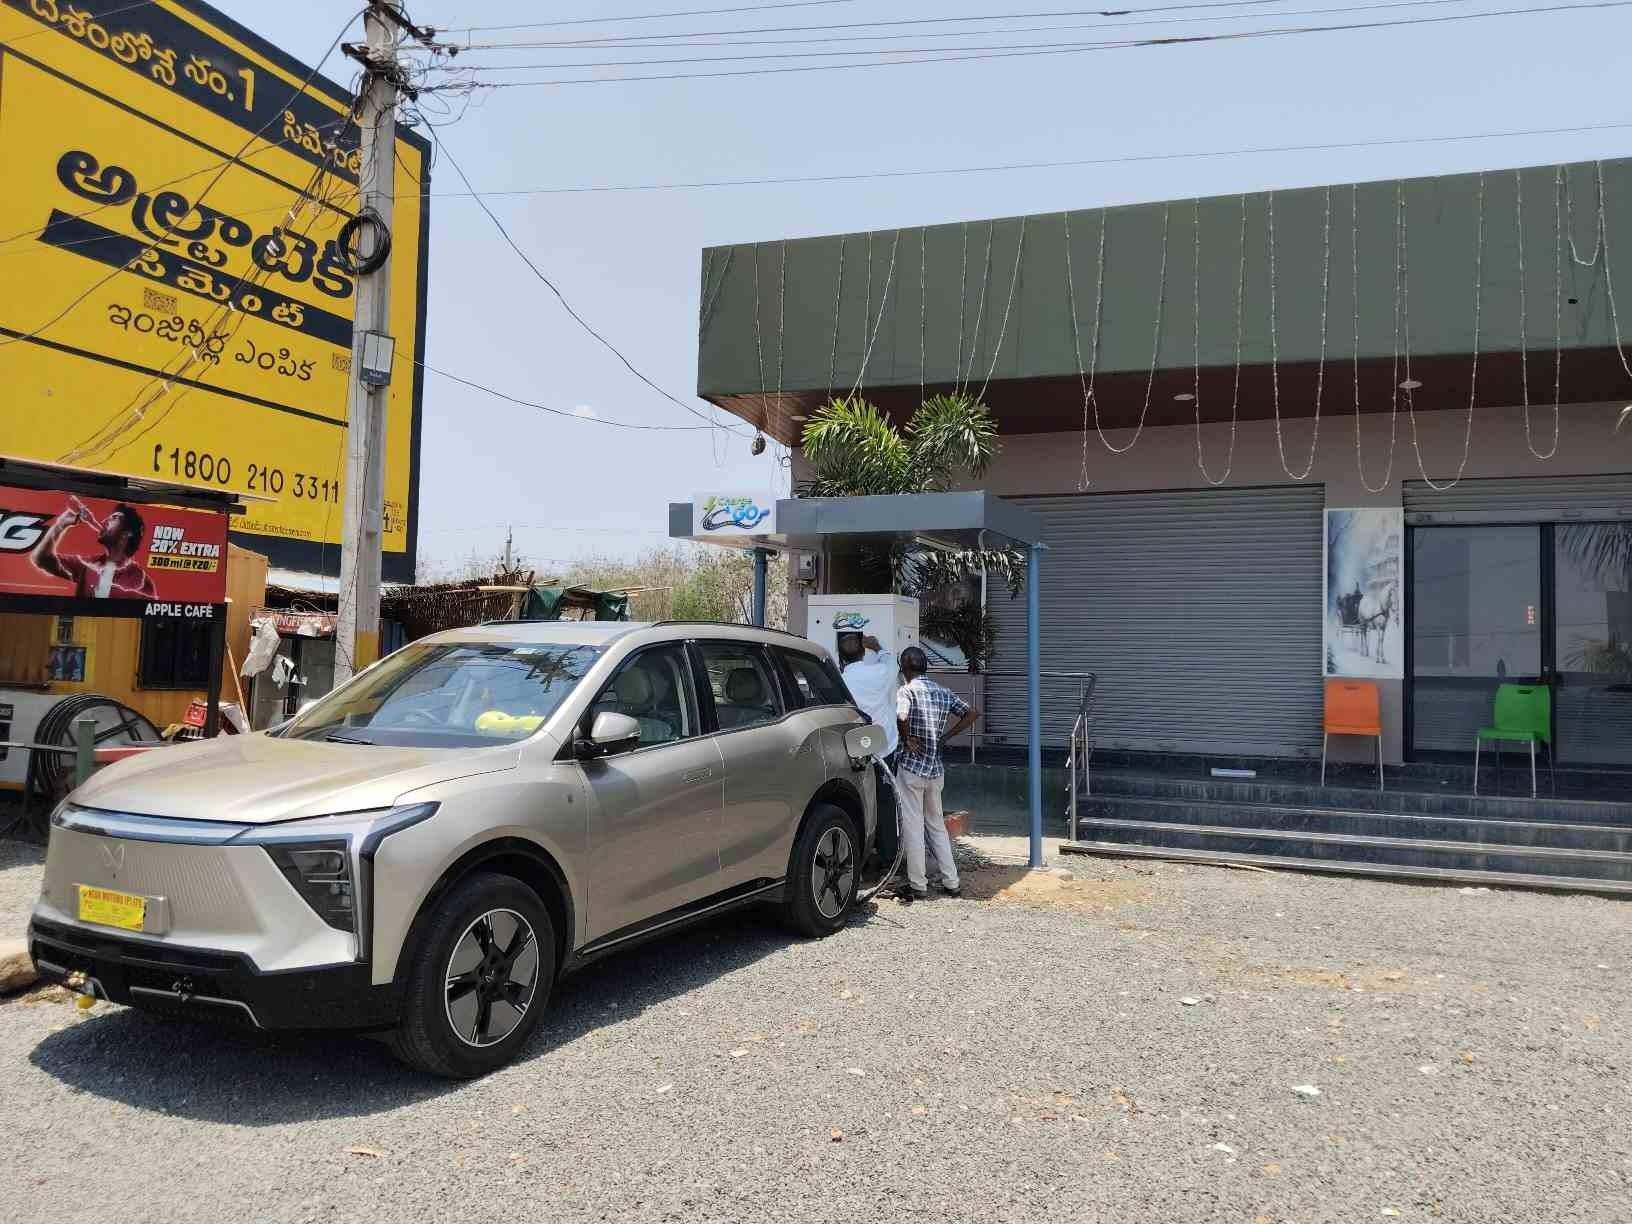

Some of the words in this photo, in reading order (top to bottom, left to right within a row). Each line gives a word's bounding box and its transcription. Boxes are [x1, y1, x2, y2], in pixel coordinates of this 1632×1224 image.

[235, 340, 317, 382] ఎంపిక
[169, 447, 232, 485] 1800
[247, 464, 284, 494] 210
[292, 473, 340, 505] 3311
[153, 525, 185, 540] NOW
[150, 539, 178, 553] 20%
[180, 541, 220, 557] EXTRA
[145, 603, 182, 617] APPLE
